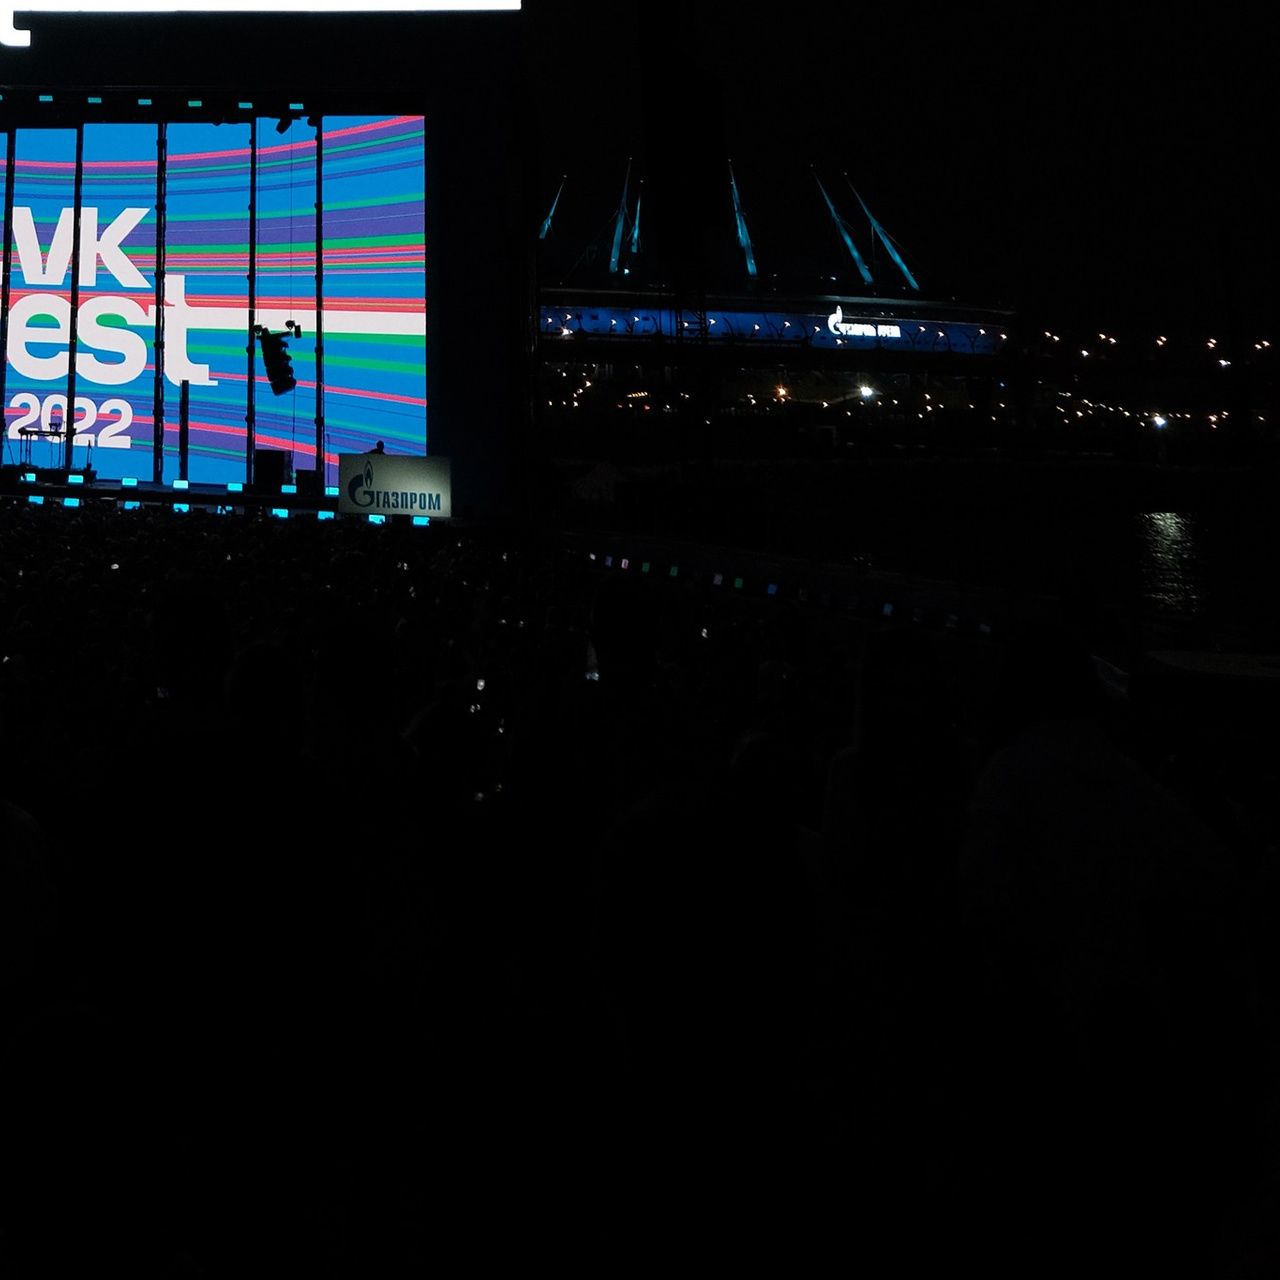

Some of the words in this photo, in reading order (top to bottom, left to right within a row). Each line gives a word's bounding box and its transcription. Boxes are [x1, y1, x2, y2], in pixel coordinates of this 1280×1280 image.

[12, 206, 153, 288] VK
[8, 392, 134, 449] 2022
[375, 491, 441, 511] ГАЗПРОМ
